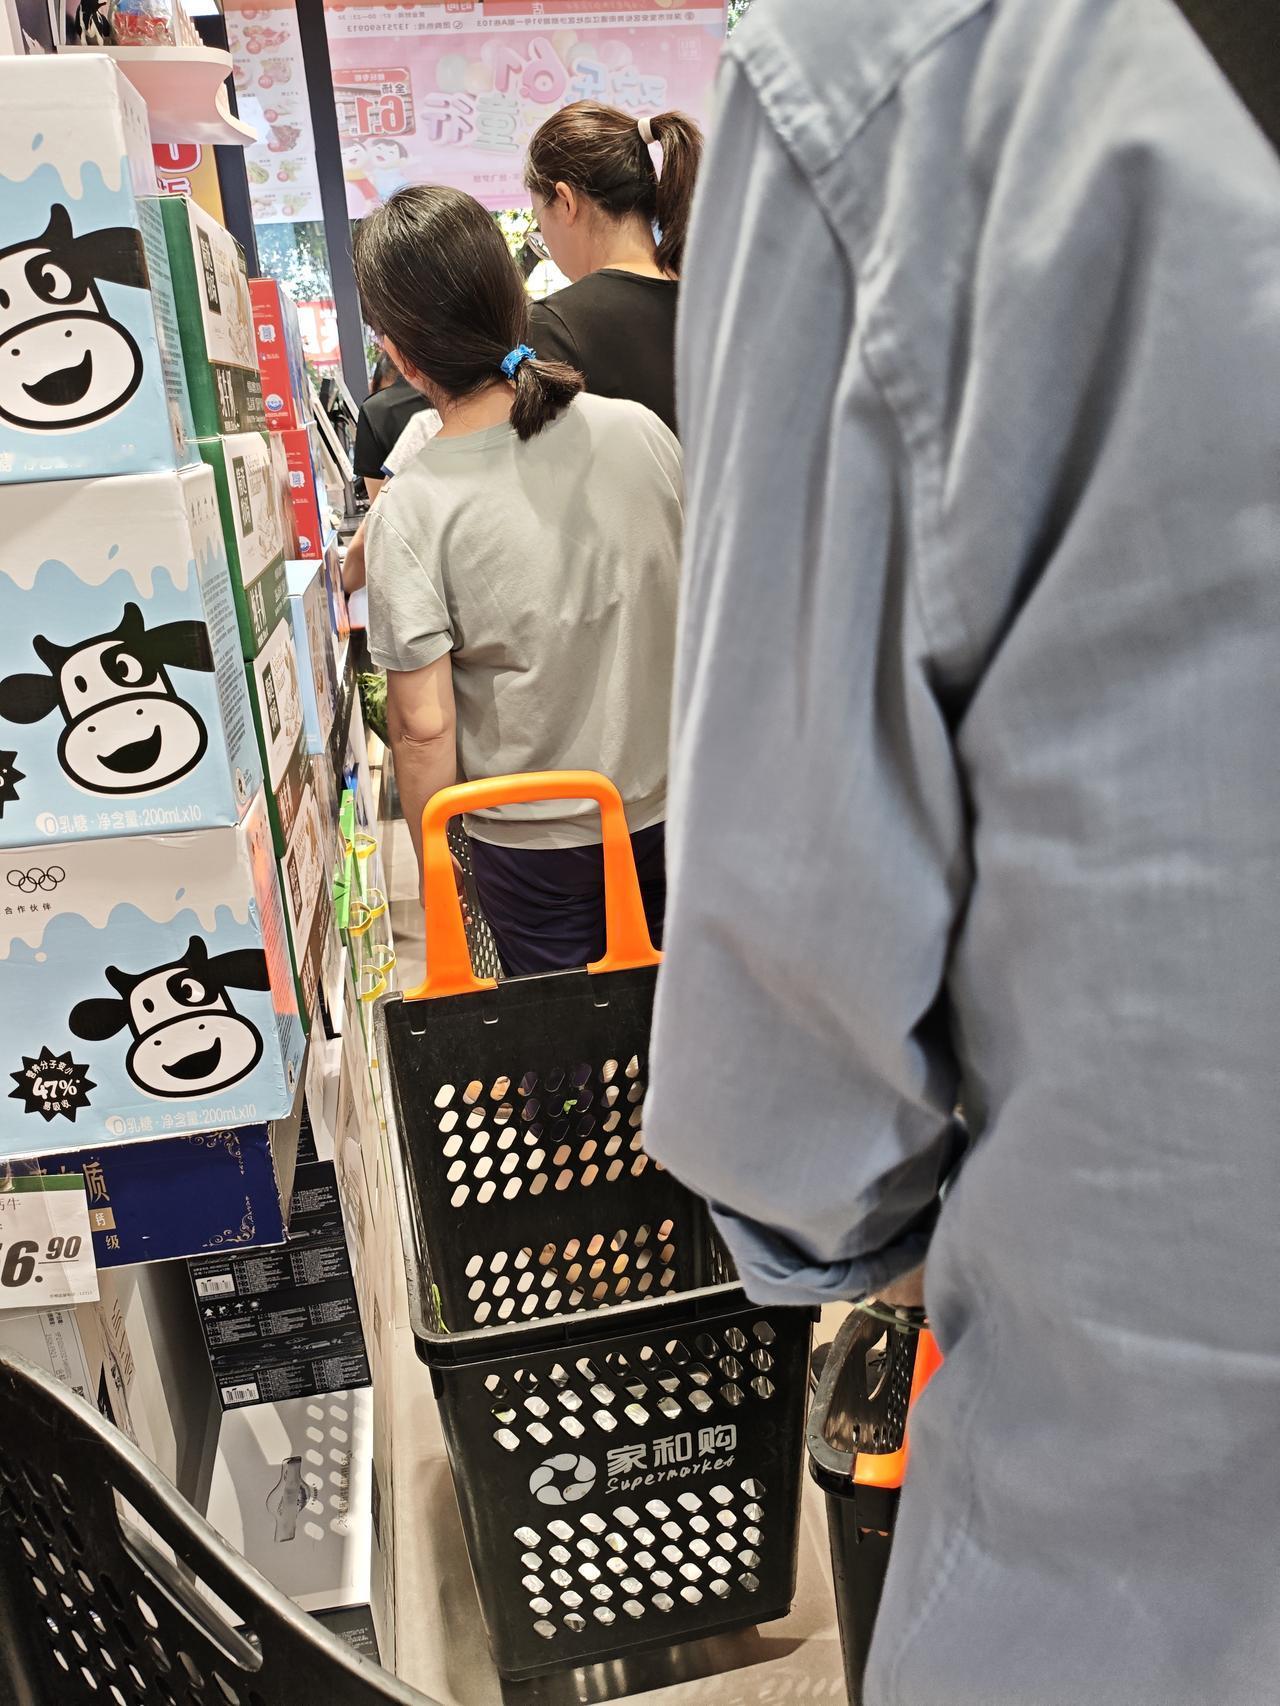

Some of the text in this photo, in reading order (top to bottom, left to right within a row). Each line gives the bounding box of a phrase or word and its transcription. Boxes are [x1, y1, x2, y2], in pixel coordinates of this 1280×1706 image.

[4, 902, 52, 915] 合作伙伴
[105, 1235, 121, 1250] 级
[607, 1424, 736, 1476] 家和购
[605, 1456, 735, 1495] Supermarket
